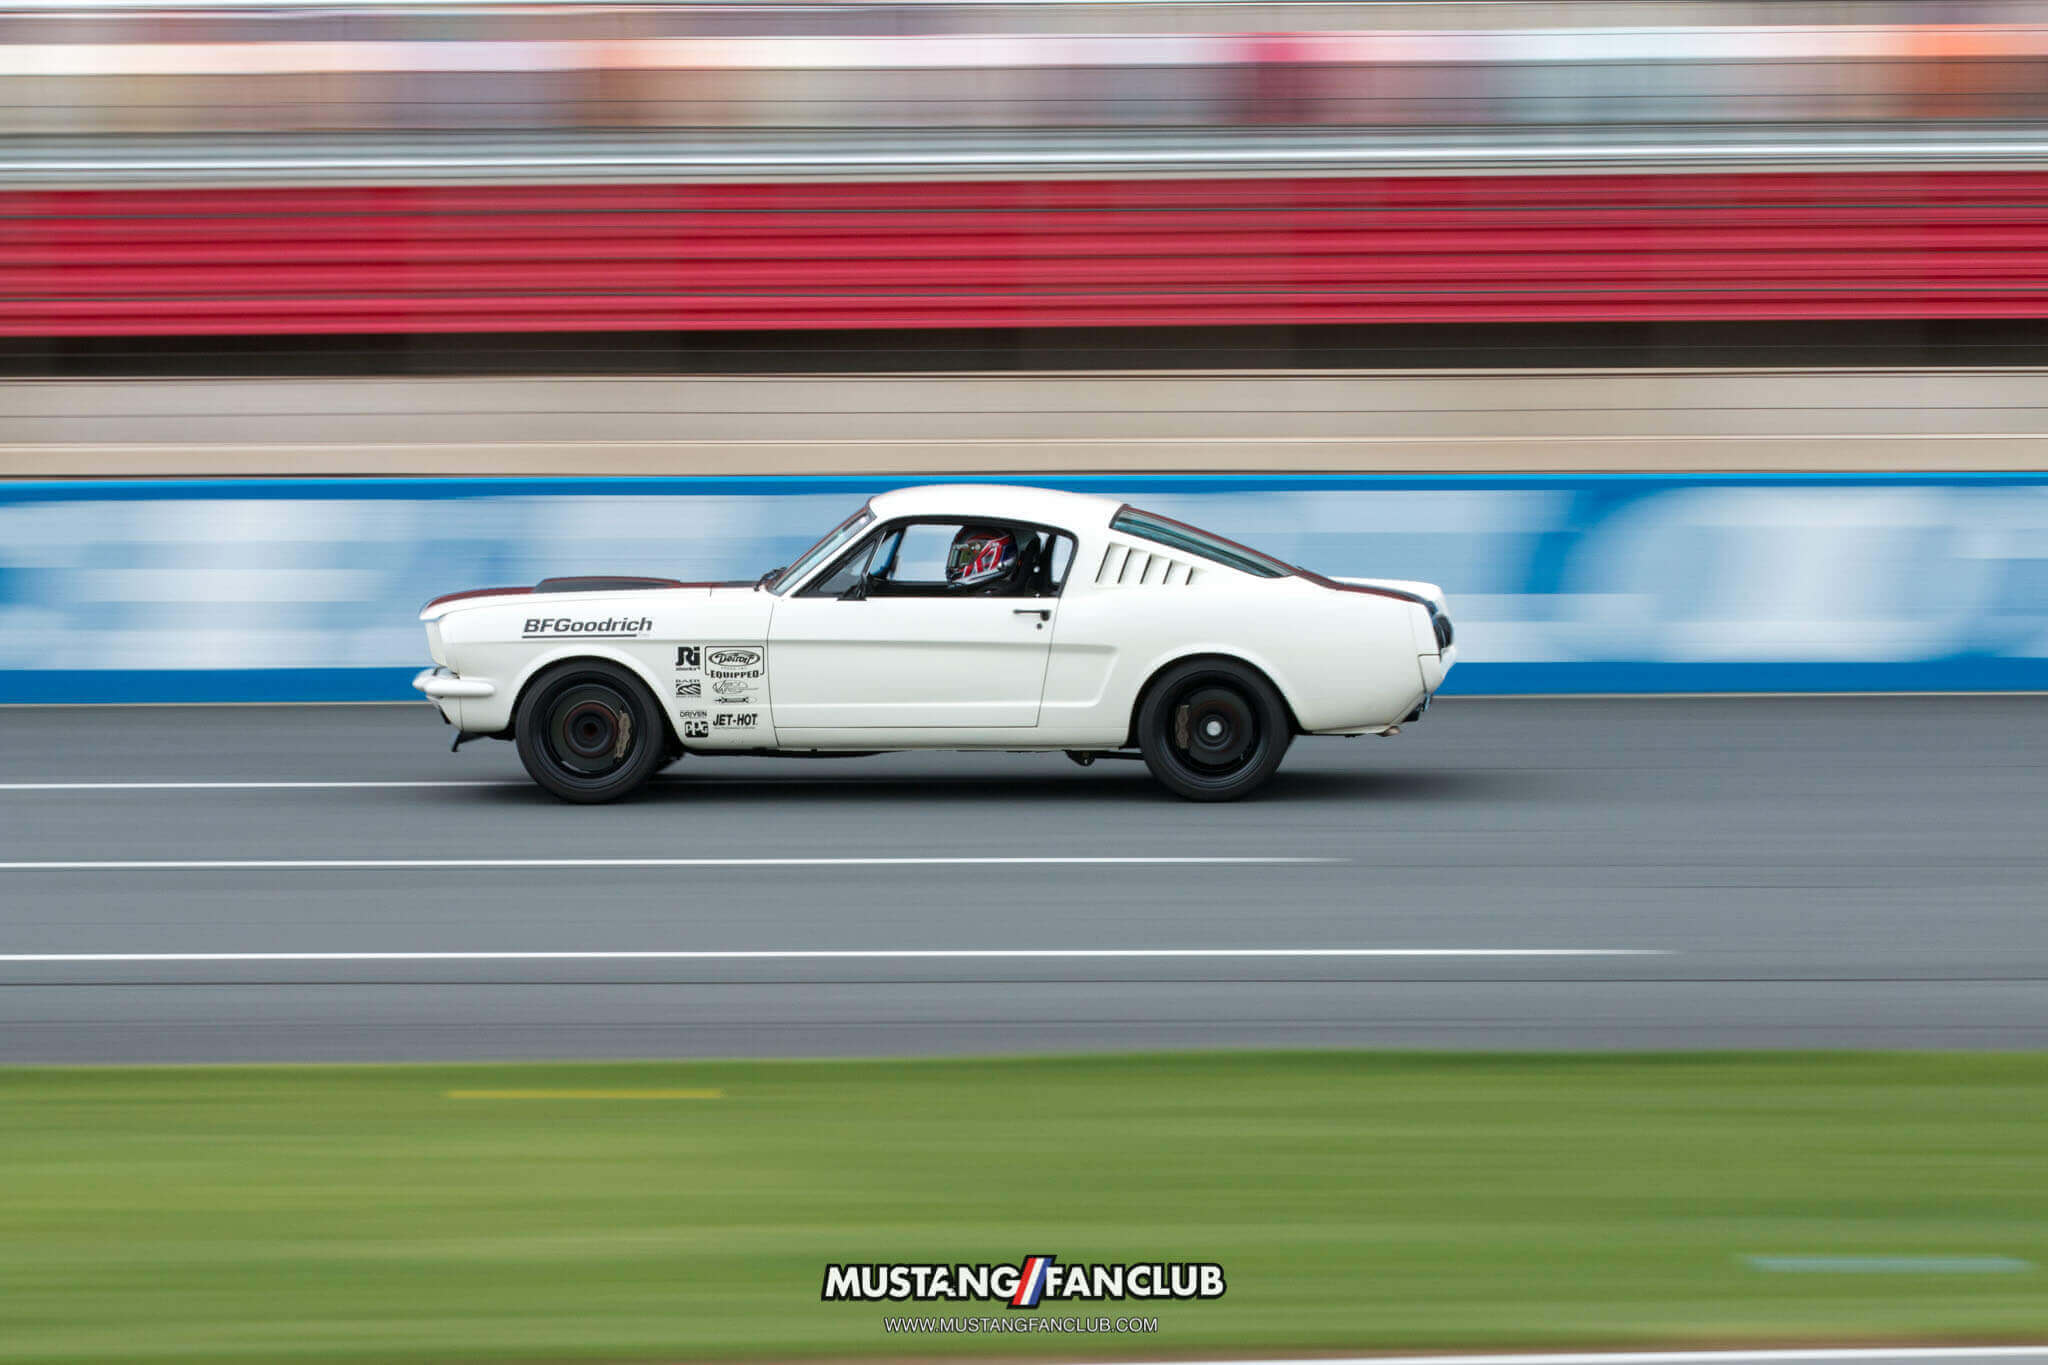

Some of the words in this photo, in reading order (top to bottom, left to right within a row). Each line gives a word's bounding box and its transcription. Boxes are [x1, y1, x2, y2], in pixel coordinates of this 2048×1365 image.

[523, 617, 653, 632] BFGoodrich
[710, 670, 759, 679] EQUIPPED
[713, 713, 758, 726] JET-HOT
[685, 722, 708, 736] PPG
